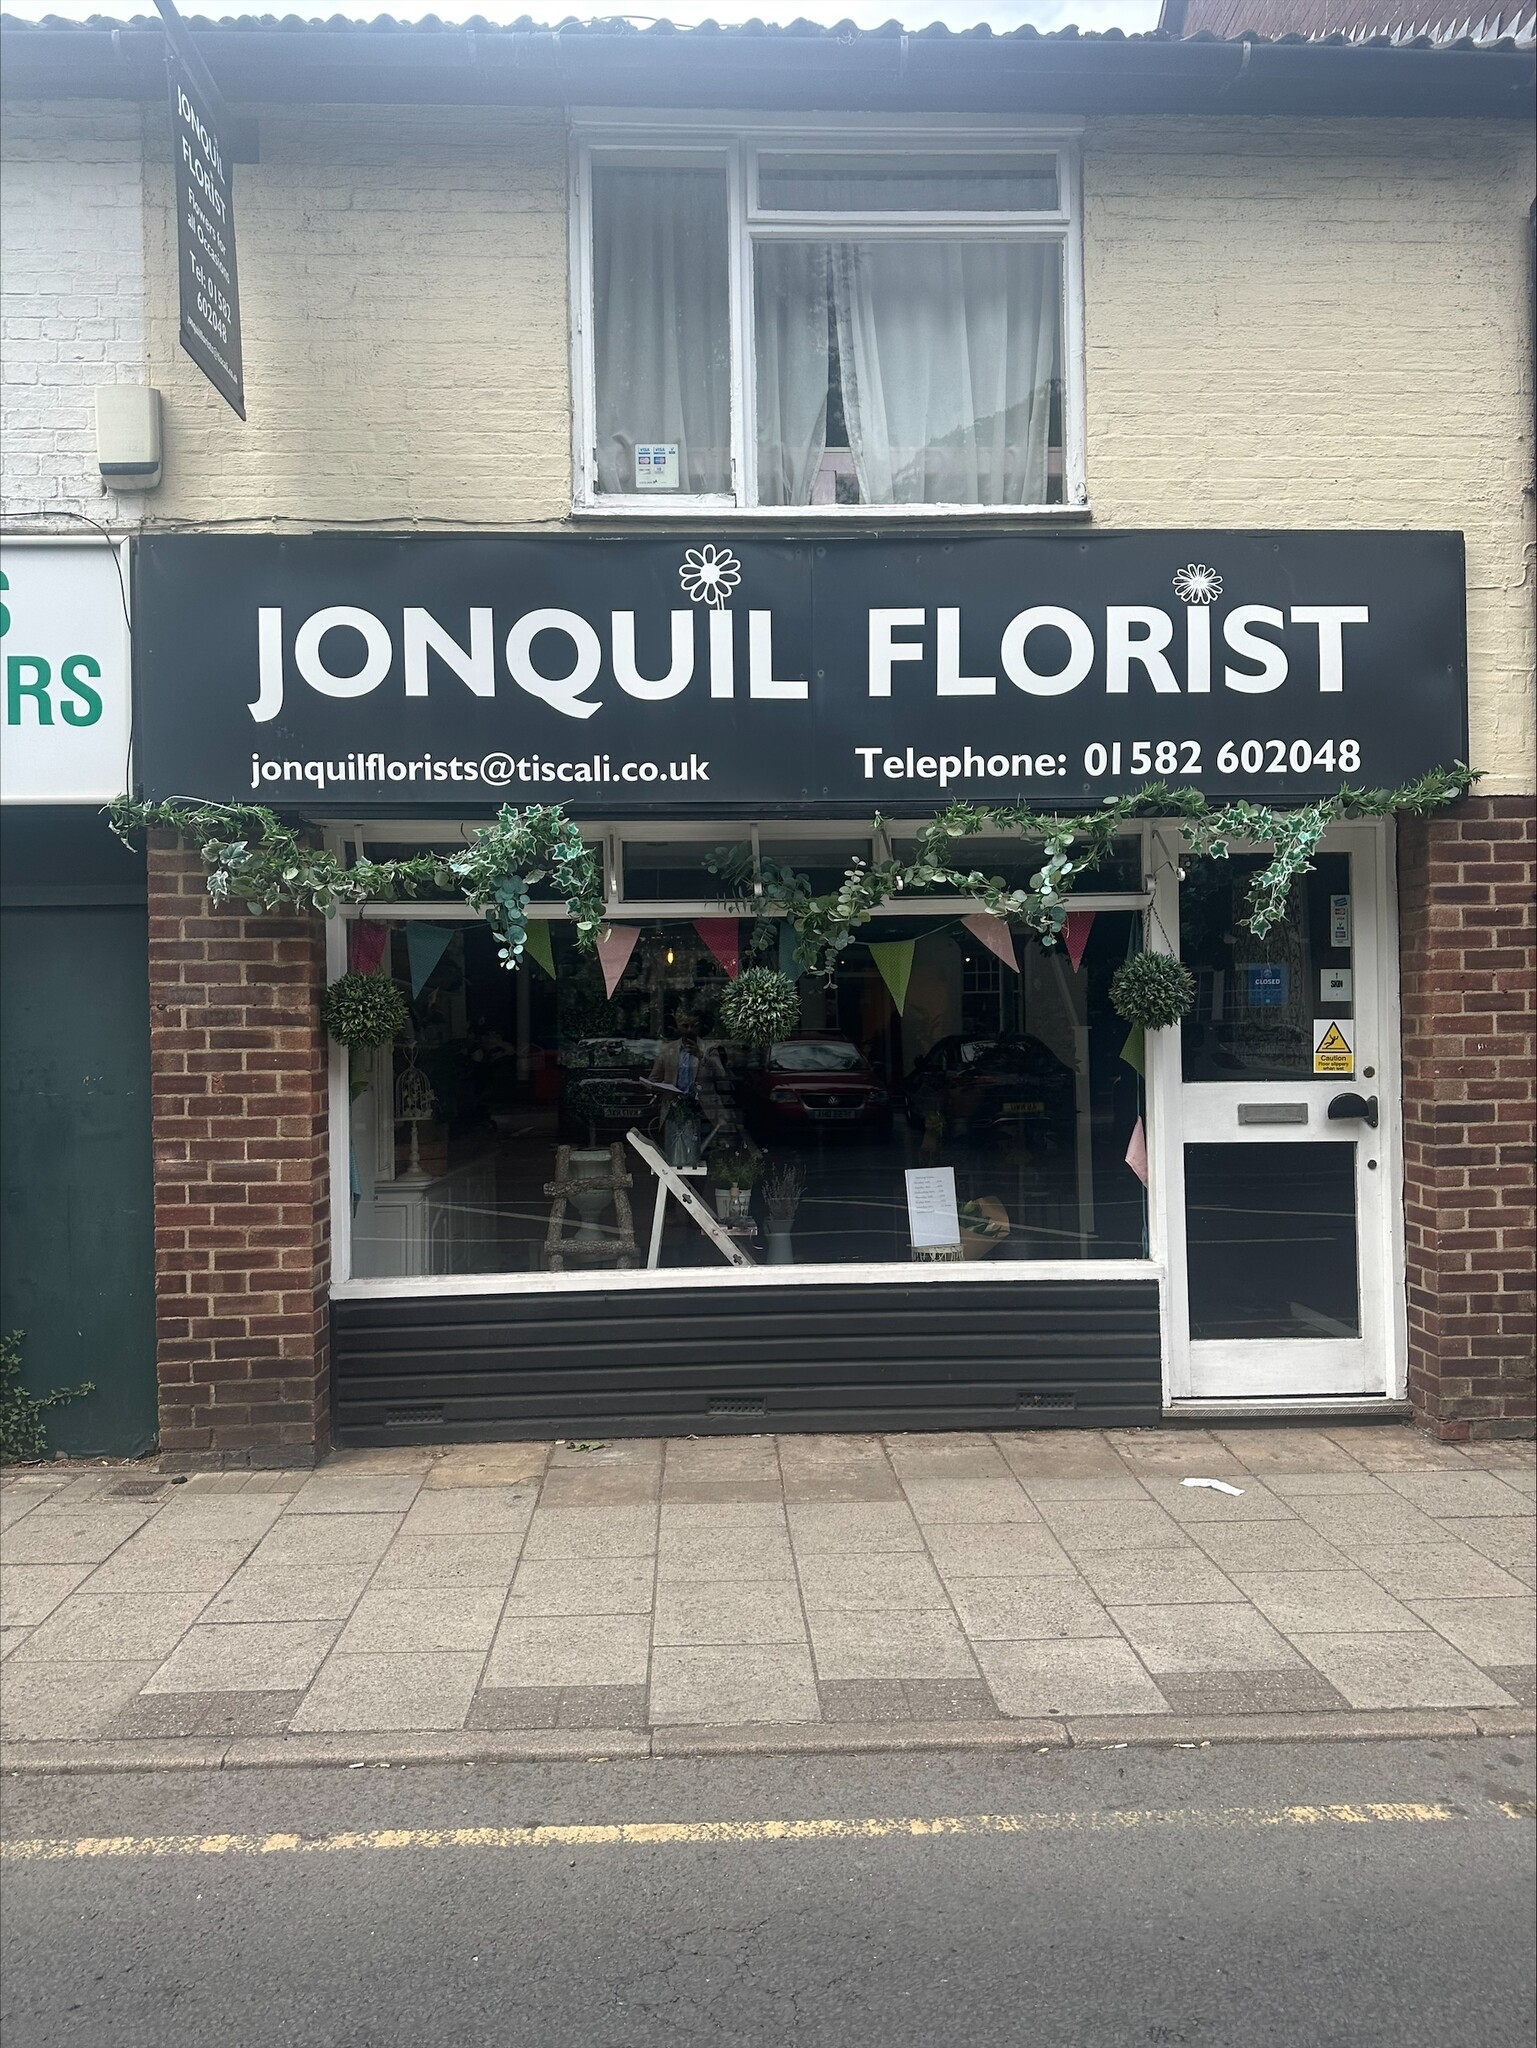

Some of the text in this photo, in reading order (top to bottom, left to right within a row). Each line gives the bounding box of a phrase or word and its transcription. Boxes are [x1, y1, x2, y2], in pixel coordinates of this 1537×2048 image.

[177, 84, 226, 185] JONQUIL
[182, 135, 227, 225] FLORIST
[188, 186, 227, 256] Flowers for
[197, 224, 231, 285] Occasions
[189, 249, 232, 326] Tel: 01582
[197, 291, 228, 344] 602048
[247, 604, 1370, 723] JONQUIL FLORIST
[250, 752, 710, 790] jonquilflorists@tiscali.co.uk
[855, 739, 1361, 788] Telephone: 01582 602048
